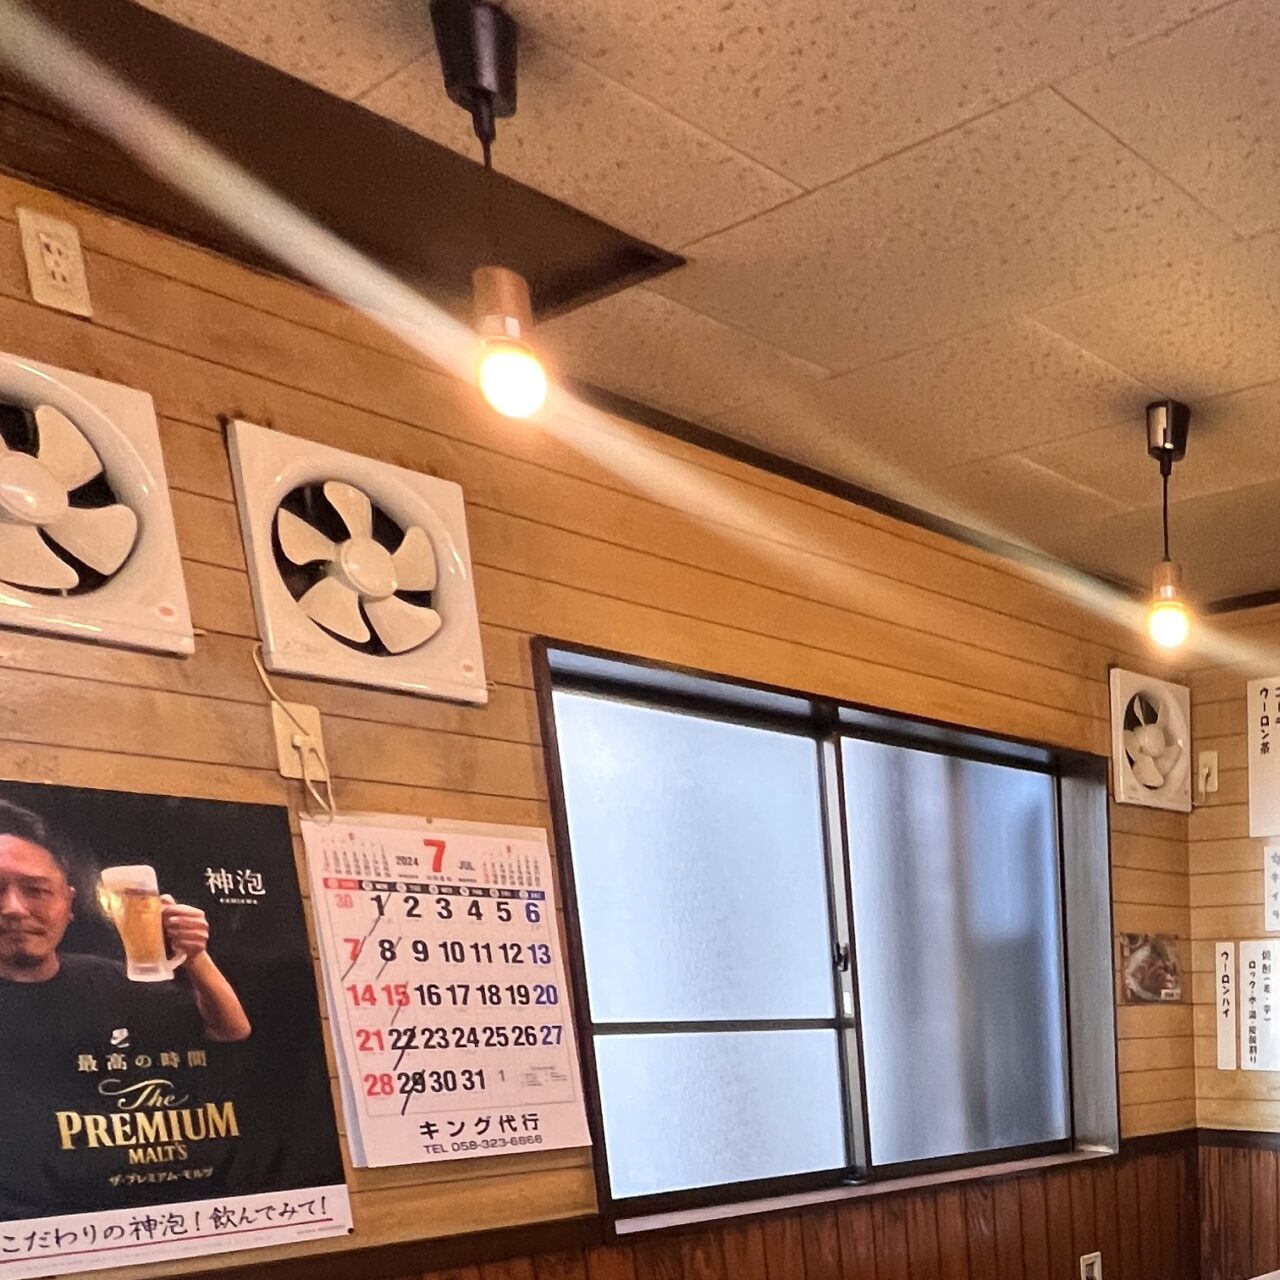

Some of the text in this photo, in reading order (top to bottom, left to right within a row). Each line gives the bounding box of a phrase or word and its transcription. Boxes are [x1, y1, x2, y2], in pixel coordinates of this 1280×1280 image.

[396, 855, 419, 867] 2024
[423, 839, 446, 873] 7
[203, 867, 267, 895] 神泡
[370, 895, 385, 916] 1
[404, 896, 422, 919] 2
[436, 898, 453, 920] 3
[467, 900, 484, 921] 4
[496, 901, 512, 922] 5
[525, 903, 541, 923] 6
[343, 938, 551, 964] 7 8 9 10 11 12 13
[347, 984, 558, 1006] 14 15 16 17 18 19 20
[1221, 950, 1230, 1018] ウーロンハイ
[356, 1025, 562, 1051] 21 22 23 24 25 26 27
[77, 1050, 207, 1073] 最高の時間
[98, 1079, 189, 1110] The
[364, 1073, 394, 1096] 28
[397, 1071, 427, 1095] 29
[429, 1070, 457, 1093] 30
[461, 1069, 486, 1090] 31
[55, 1101, 240, 1151] PREMIUM
[419, 1113, 539, 1140] キング代行
[423, 1144, 449, 1154] TEL
